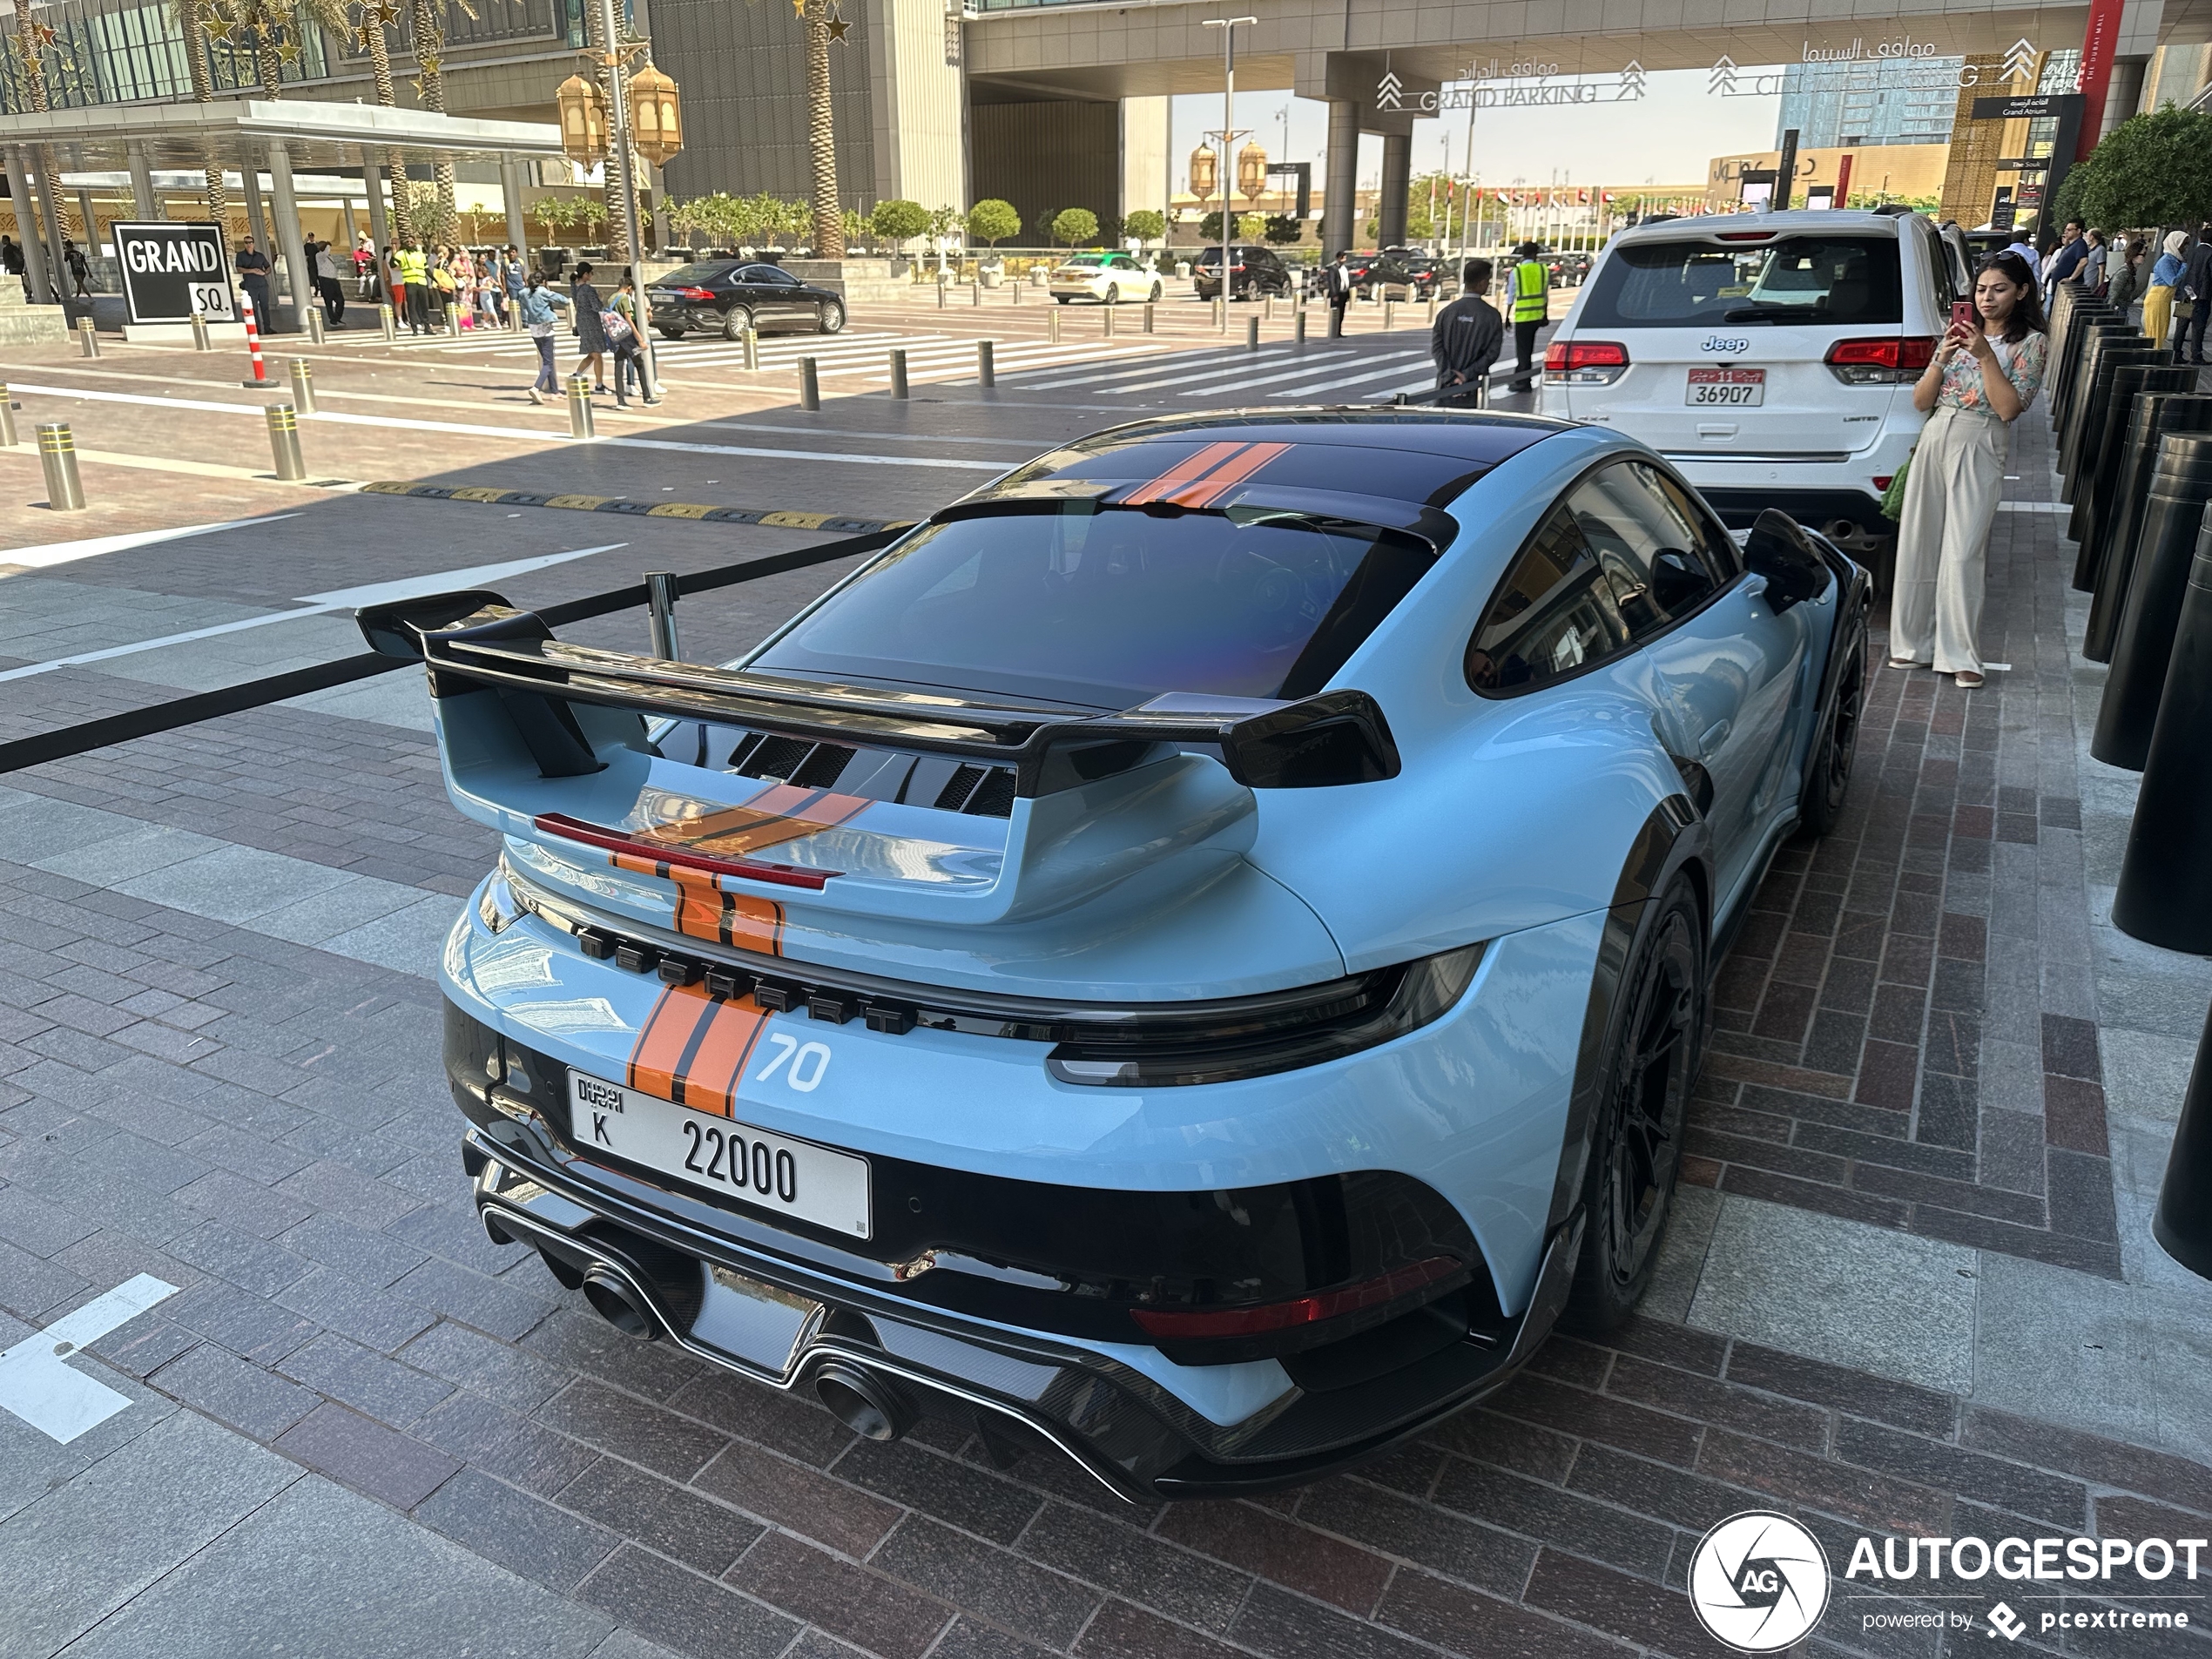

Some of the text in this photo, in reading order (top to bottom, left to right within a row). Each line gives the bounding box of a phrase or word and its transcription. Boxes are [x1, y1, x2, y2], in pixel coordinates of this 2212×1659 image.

[1803, 35, 1935, 66] مواقف السينما
[2087, 13, 2105, 80] THE DUBAI MALL
[1757, 64, 1979, 96] CINEMA PARKING
[1420, 84, 1596, 111] GRAND PARKING
[127, 239, 219, 273] GRAND
[196, 287, 230, 313] SQ.
[1701, 335, 1750, 354] Jeep
[1716, 371, 1734, 383] 11
[1696, 386, 1753, 404] 36907
[578, 932, 907, 1036] TECHART
[755, 1033, 832, 1092] 70
[592, 1110, 612, 1147] K
[683, 1119, 797, 1204] 22000
